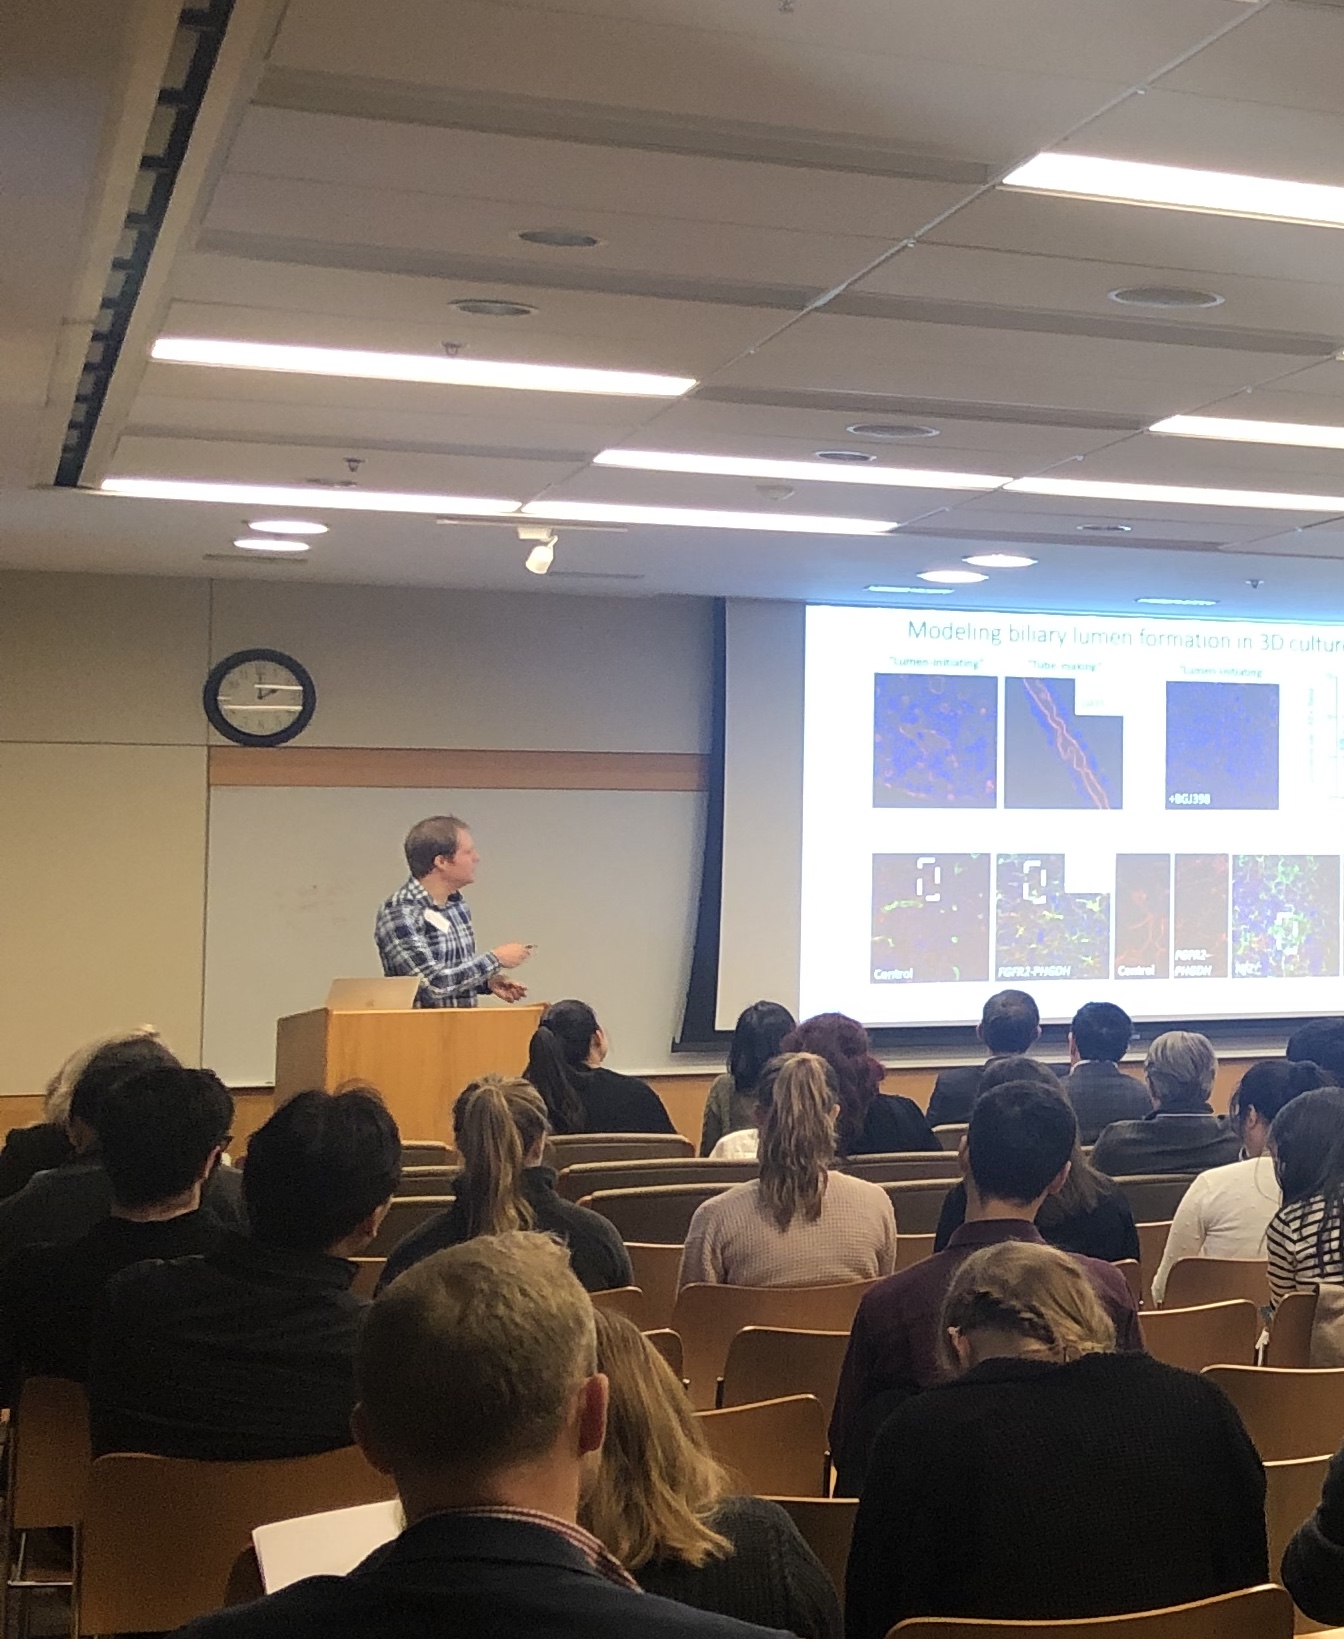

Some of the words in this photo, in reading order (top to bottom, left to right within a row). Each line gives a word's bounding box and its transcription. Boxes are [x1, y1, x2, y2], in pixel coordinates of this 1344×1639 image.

[908, 620, 1001, 646] Modeling
[1009, 623, 1067, 647] biliary
[1074, 627, 1132, 646] lumen
[1140, 628, 1230, 649] formation
[1237, 633, 1253, 650] in
[1260, 633, 1284, 651] 3D
[873, 968, 913, 980] Control
[1118, 964, 1155, 976] Control
